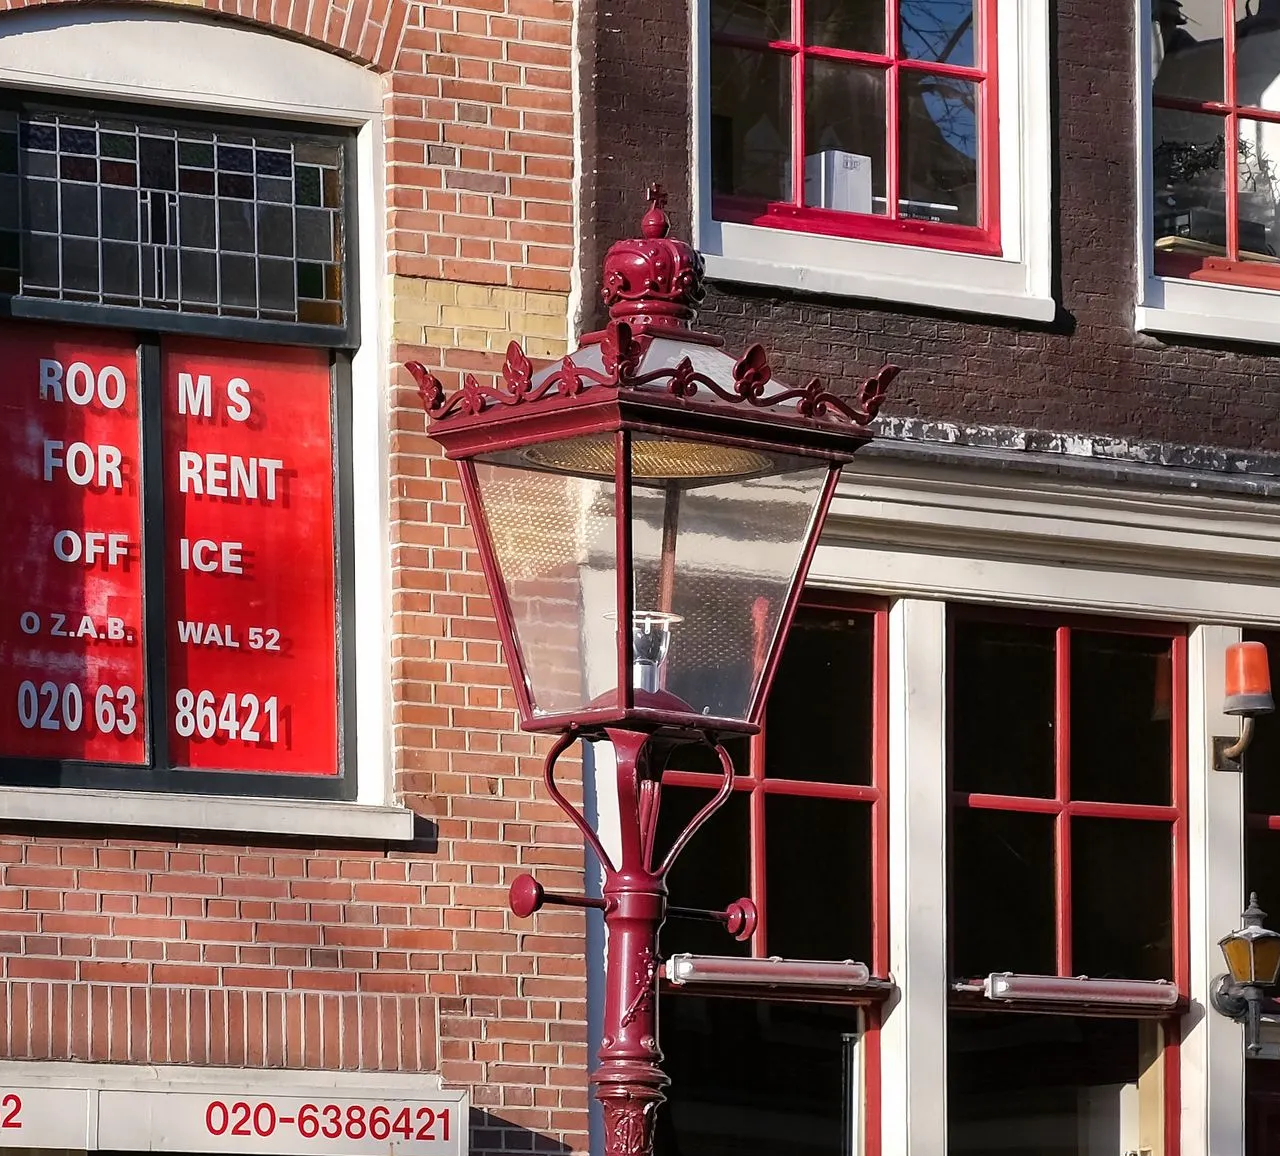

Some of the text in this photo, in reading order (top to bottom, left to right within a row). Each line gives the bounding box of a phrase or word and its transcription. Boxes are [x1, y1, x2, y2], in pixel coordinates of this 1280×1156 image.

[39, 358, 128, 409] ROO
[43, 439, 283, 500] FOR RENT
[53, 529, 243, 575] OFF ICE
[177, 620, 240, 648] WAL
[248, 627, 281, 651] 52
[18, 680, 278, 743] 020 63 86421
[205, 1101, 451, 1143] 020-6386421
